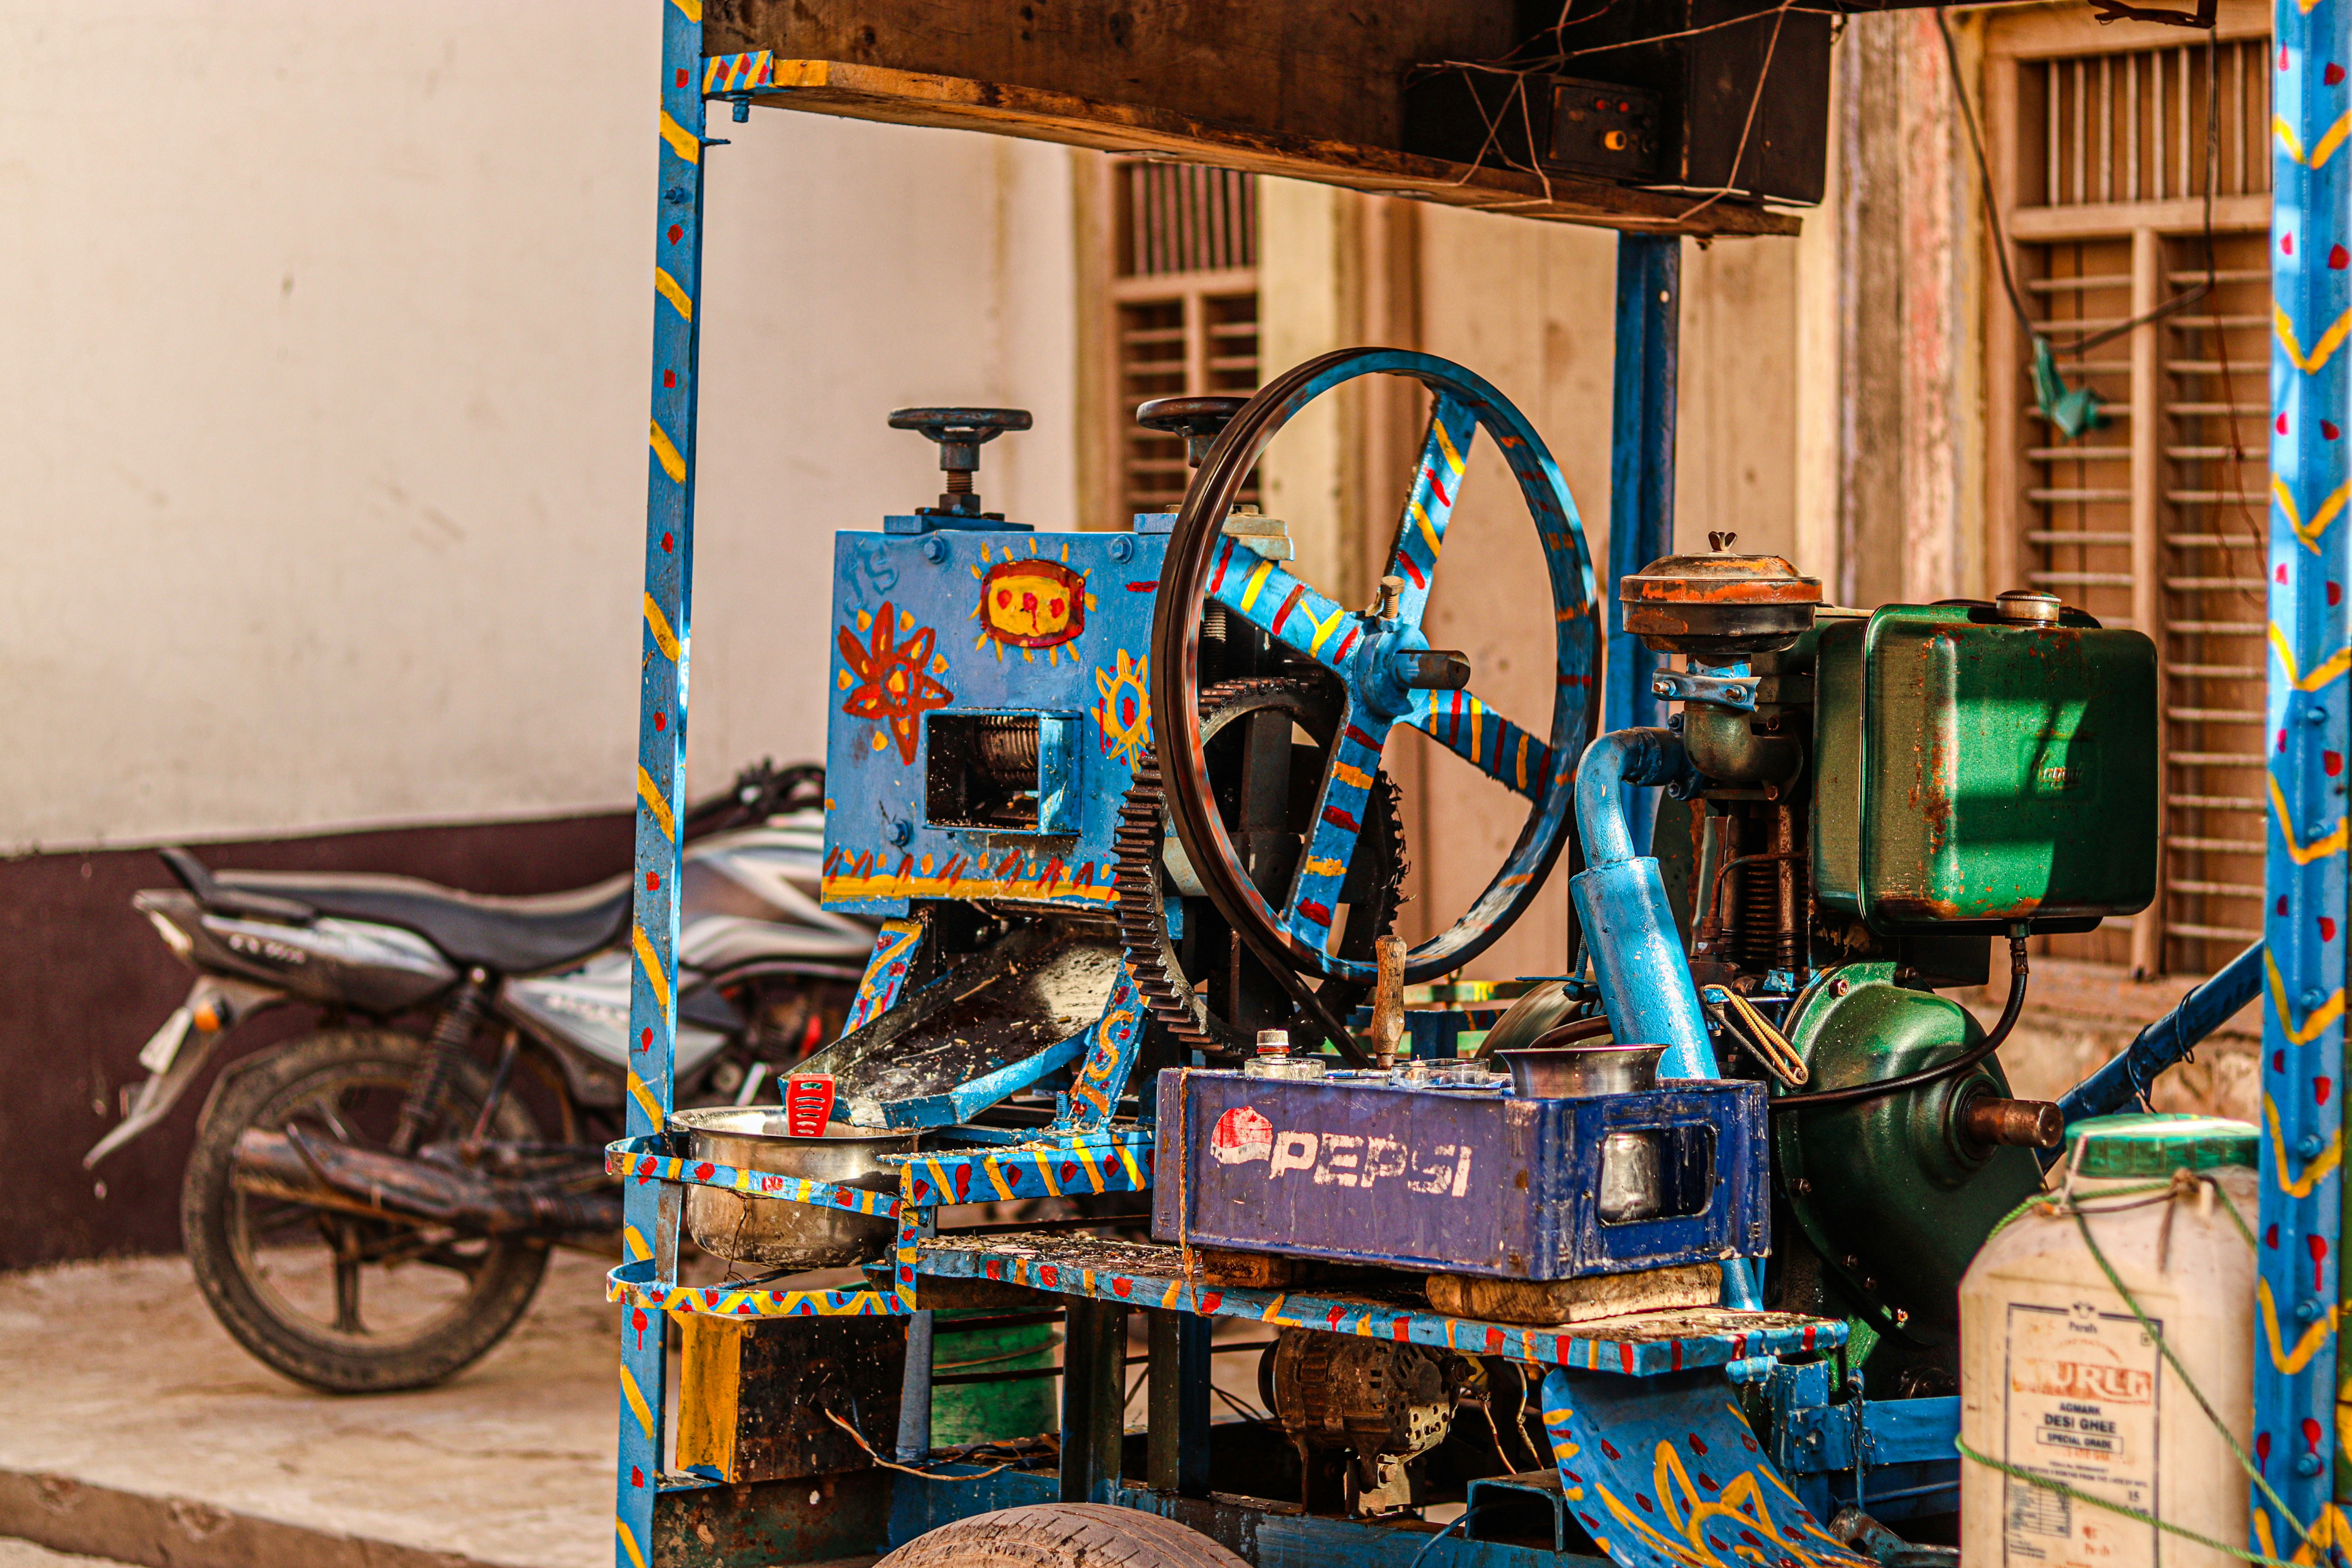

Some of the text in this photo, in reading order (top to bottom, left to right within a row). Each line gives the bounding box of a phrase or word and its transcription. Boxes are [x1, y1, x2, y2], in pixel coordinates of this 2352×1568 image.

[1269, 1131, 1472, 1197] PEPSI
[2060, 1402, 2101, 1416] AGMARK
[2044, 1413, 2116, 1434] DESI GHEE
[2047, 1433, 2112, 1450] SPECIAL GRADE
